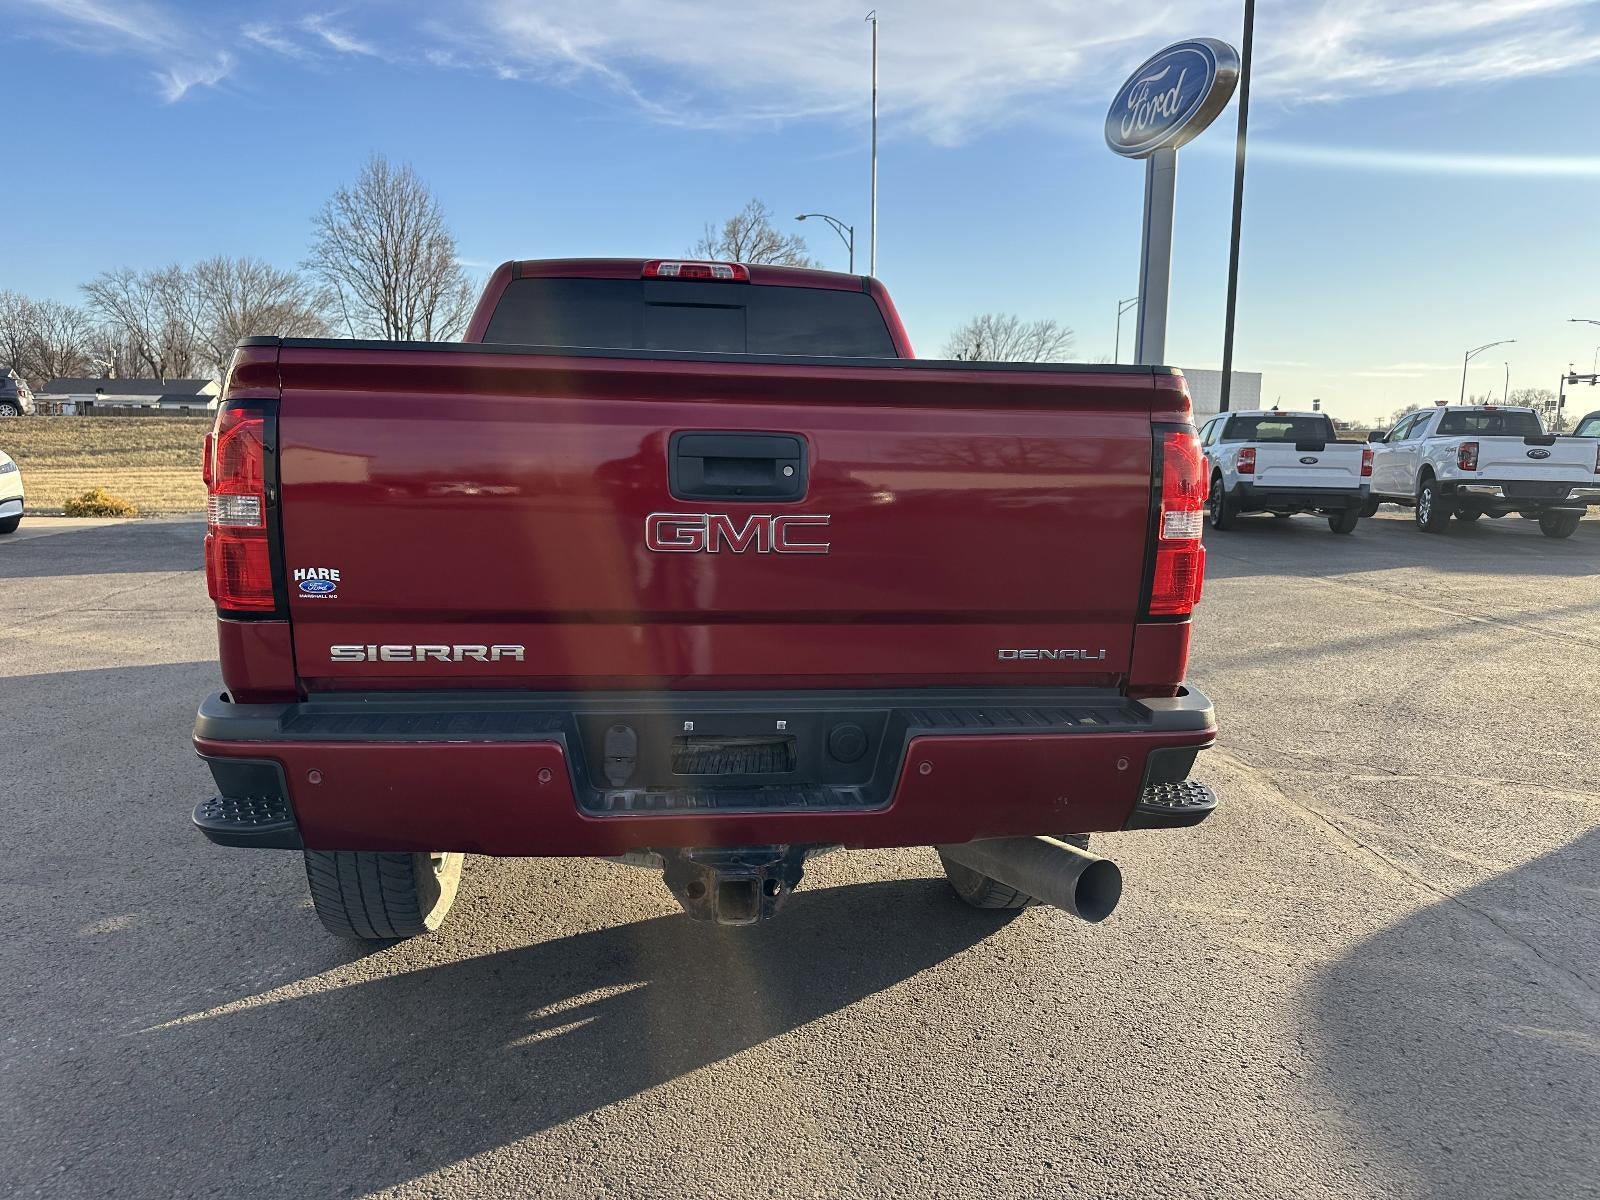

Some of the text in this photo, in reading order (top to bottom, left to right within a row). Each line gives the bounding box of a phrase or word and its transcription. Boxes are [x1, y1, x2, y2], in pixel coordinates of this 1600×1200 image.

[1121, 64, 1187, 139] Ford
[645, 512, 831, 553] GMC
[293, 567, 341, 582] HARE
[307, 582, 328, 591] Ford
[330, 644, 525, 662] SIERRA
[998, 649, 1106, 661] DENALI
